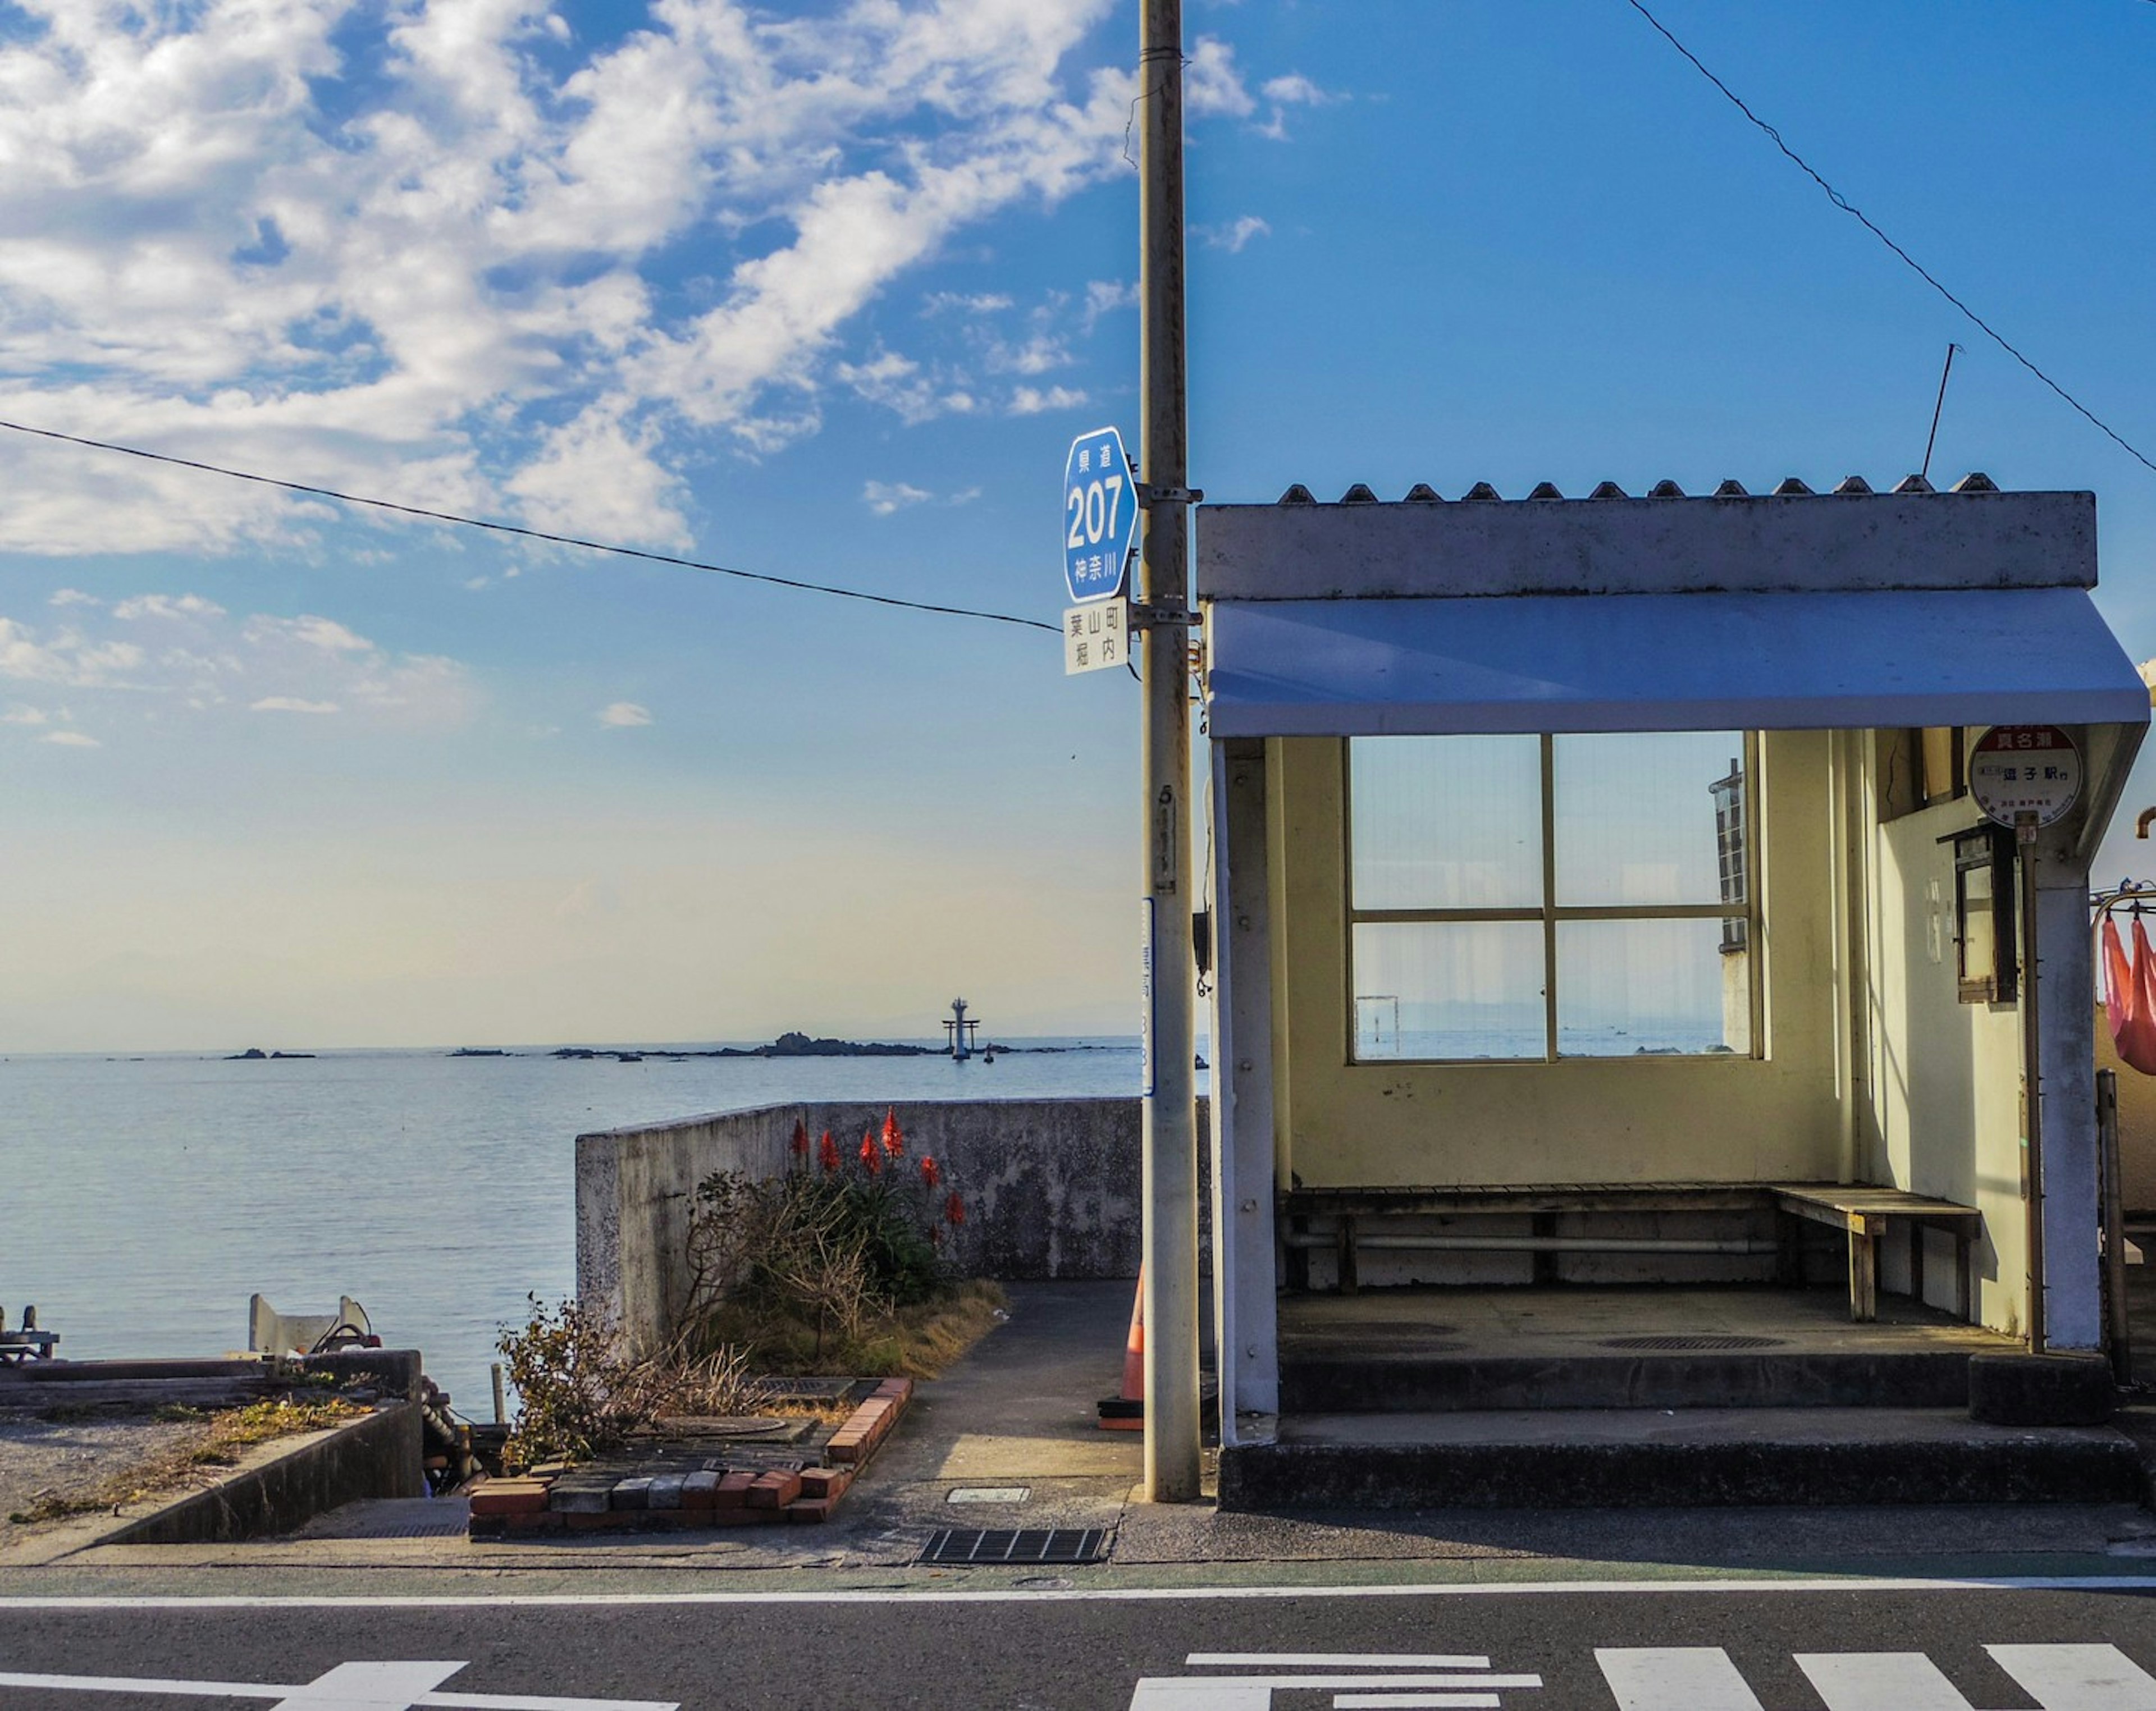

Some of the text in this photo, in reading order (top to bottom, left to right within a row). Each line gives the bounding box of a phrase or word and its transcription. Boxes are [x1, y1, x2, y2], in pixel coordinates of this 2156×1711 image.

[1079, 444, 1111, 473] 県道
[1068, 475, 1122, 548] 207
[1075, 552, 1116, 583] 神奈川
[1071, 606, 1118, 638] 葉山町
[1076, 637, 1114, 666] 堀内
